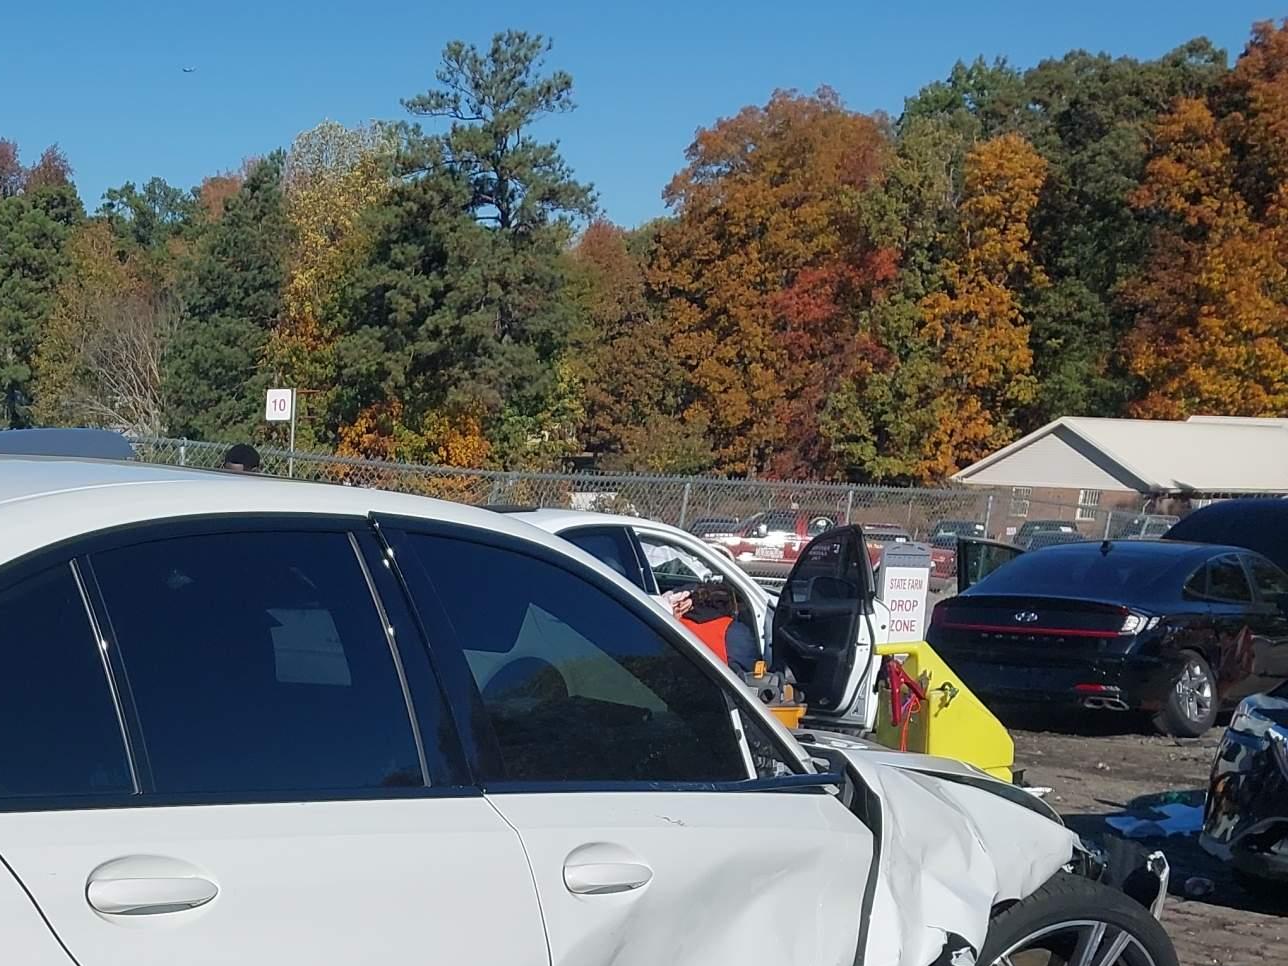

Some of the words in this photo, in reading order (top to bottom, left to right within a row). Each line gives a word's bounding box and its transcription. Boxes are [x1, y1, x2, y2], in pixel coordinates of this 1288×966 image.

[271, 398, 286, 412] 10
[889, 578, 907, 590] STATE
[907, 579, 923, 591] FARM
[890, 599, 919, 613] DROP
[890, 619, 917, 632] ZONE
